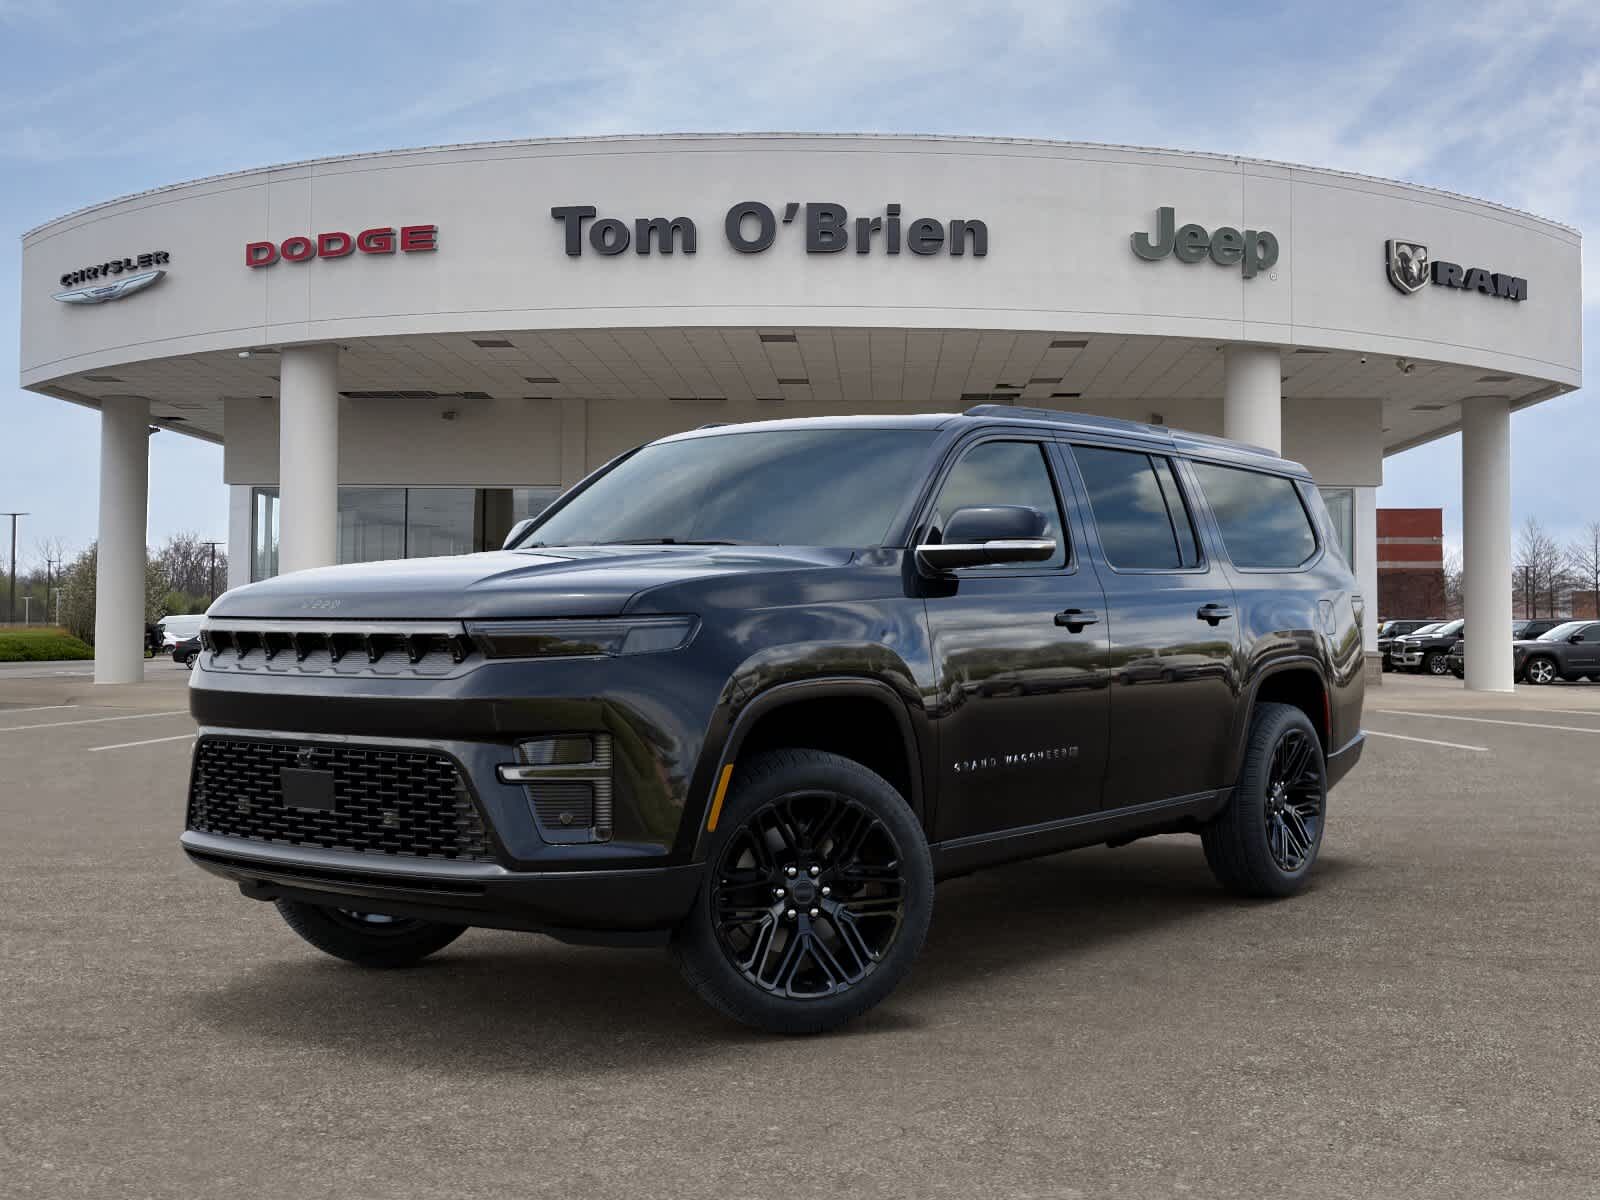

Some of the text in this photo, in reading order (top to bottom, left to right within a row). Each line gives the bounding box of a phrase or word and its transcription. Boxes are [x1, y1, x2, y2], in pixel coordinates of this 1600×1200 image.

[245, 225, 438, 269] DODGE
[551, 201, 988, 256] Tom O'Brien
[1130, 206, 1279, 279] Jeep
[60, 250, 170, 287] CHRYSLER
[1431, 260, 1528, 301] RAM
